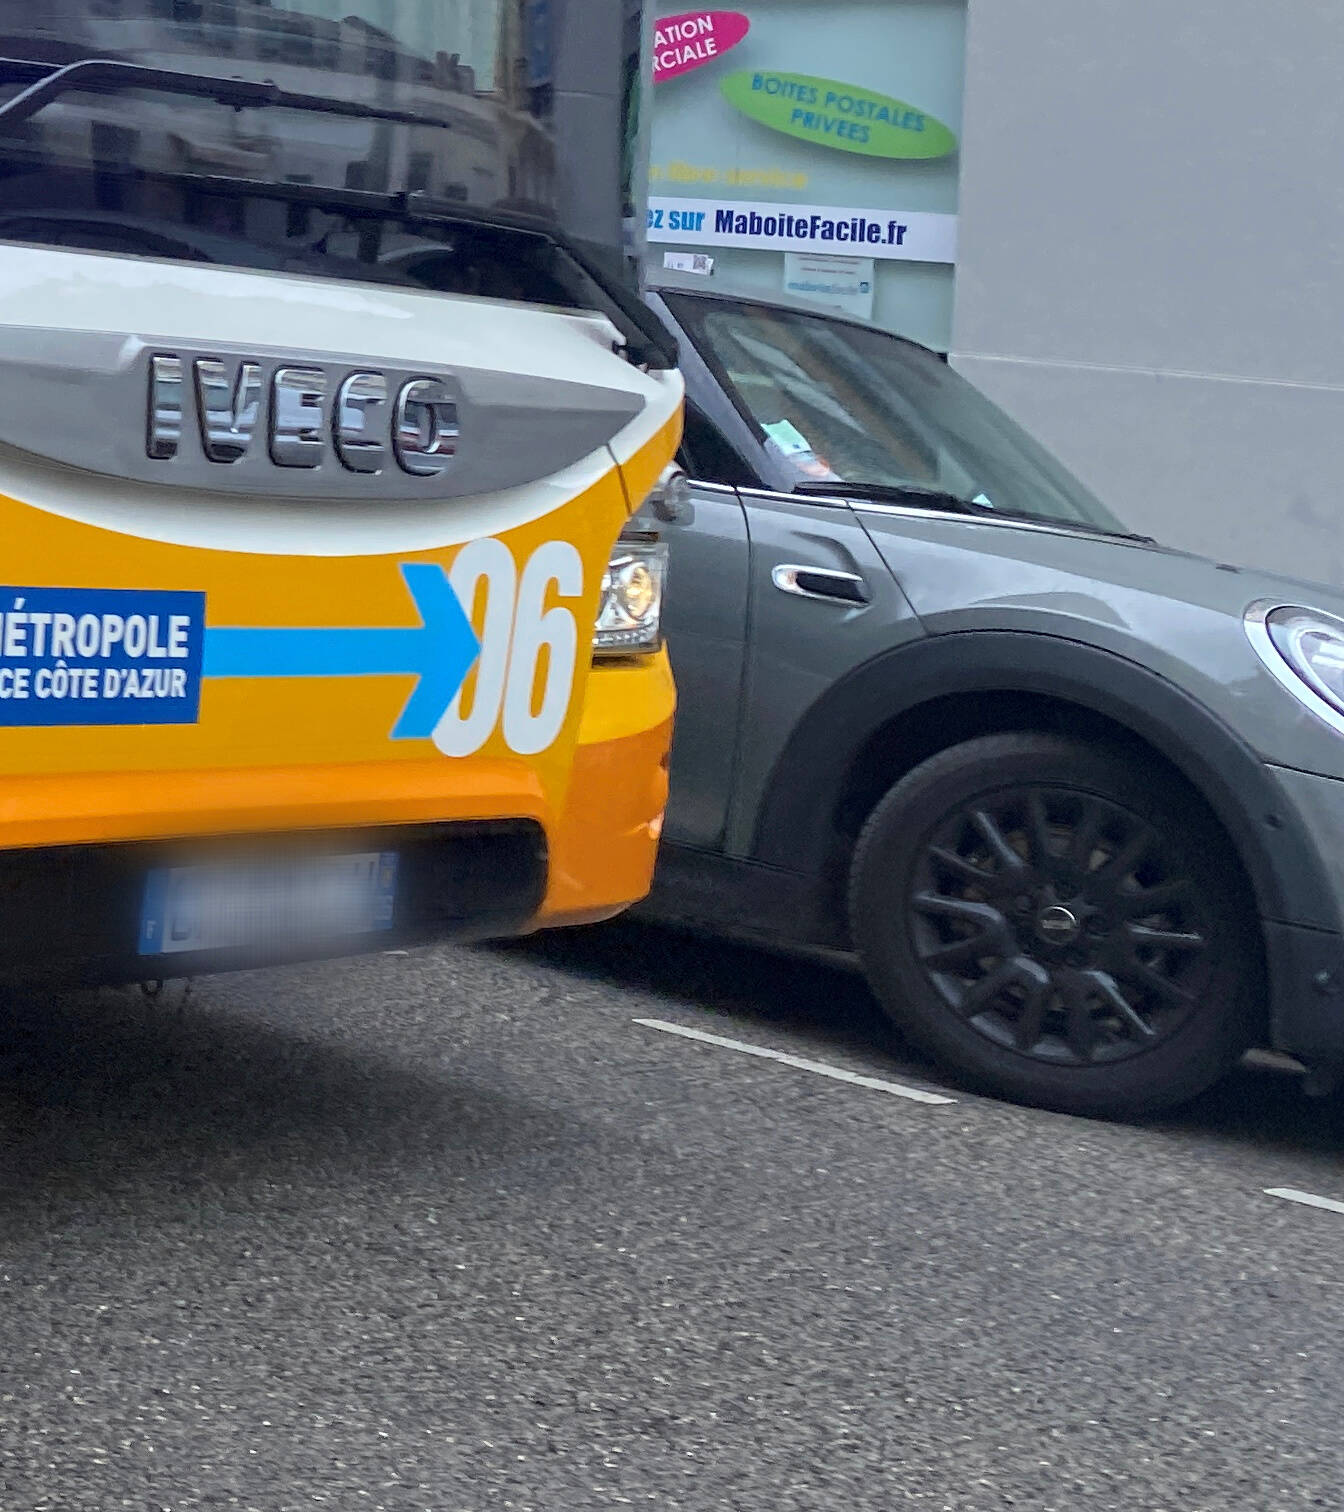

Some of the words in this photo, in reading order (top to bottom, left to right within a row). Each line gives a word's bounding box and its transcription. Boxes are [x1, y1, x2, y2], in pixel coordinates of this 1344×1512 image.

[653, 15, 715, 50] ATION
[750, 72, 818, 106] BOITES
[824, 90, 926, 134] POSTALES
[790, 107, 871, 145] PRIVEES
[668, 209, 706, 233] sur
[714, 208, 909, 247] MaboiteFacile.fr
[145, 352, 461, 478] IVECO
[430, 536, 585, 759] 06
[33, 659, 101, 702] CÔTE
[102, 666, 188, 701] D'AZUR
